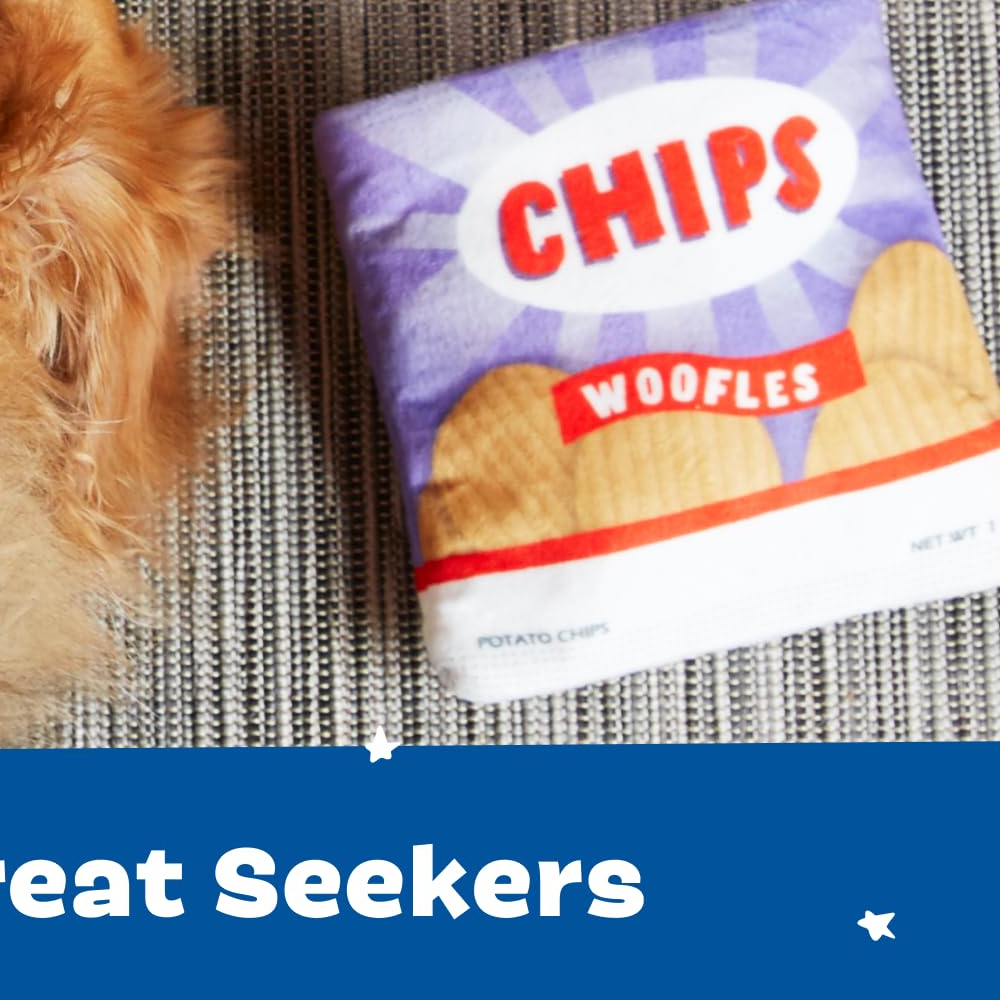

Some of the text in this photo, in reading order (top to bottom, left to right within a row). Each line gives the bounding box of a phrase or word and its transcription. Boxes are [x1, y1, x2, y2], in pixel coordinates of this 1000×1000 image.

[497, 115, 821, 277] CHIPS
[580, 363, 820, 419] WOOFLES
[910, 533, 943, 552] NET
[477, 622, 610, 649] POTATO CHIPS
